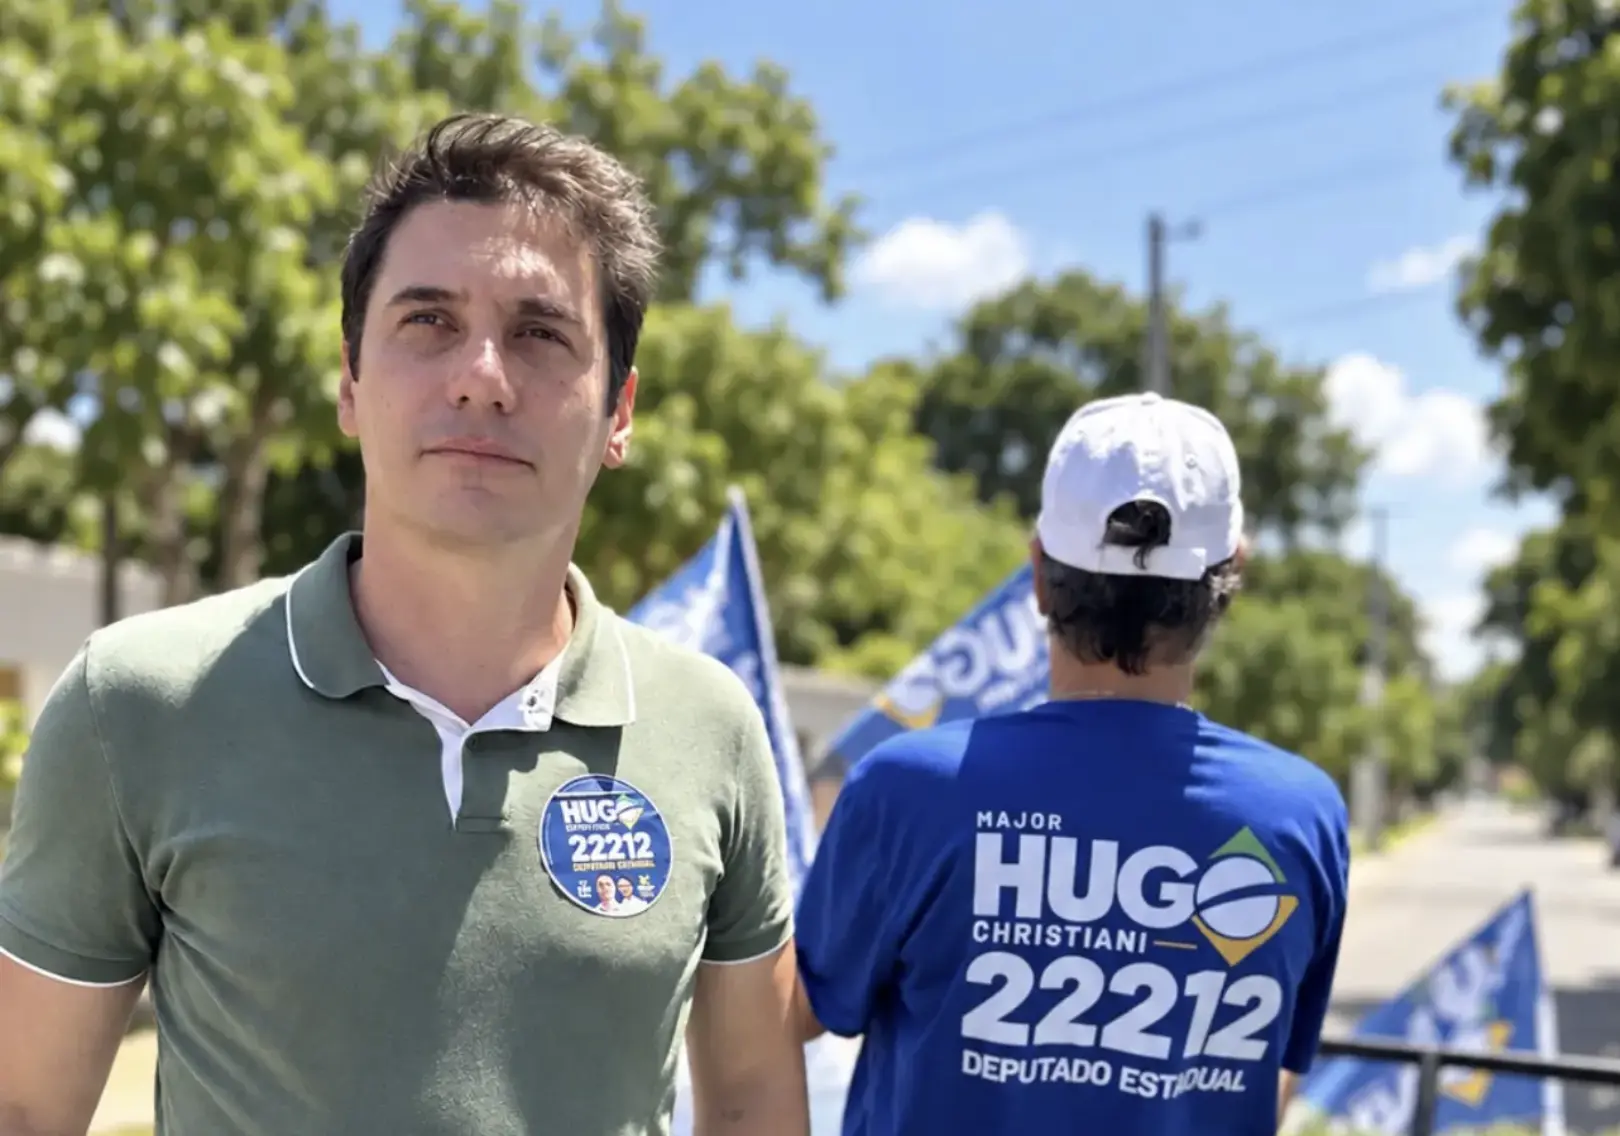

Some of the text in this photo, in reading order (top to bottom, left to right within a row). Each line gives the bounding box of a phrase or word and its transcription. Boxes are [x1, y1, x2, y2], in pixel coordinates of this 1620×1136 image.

[976, 811, 1062, 831] MAJOR
[568, 831, 655, 862] 22212
[972, 920, 1147, 953] CHRISTIANI
[961, 951, 1283, 1060] 22212
[962, 1049, 1112, 1086] DEPUTADO
